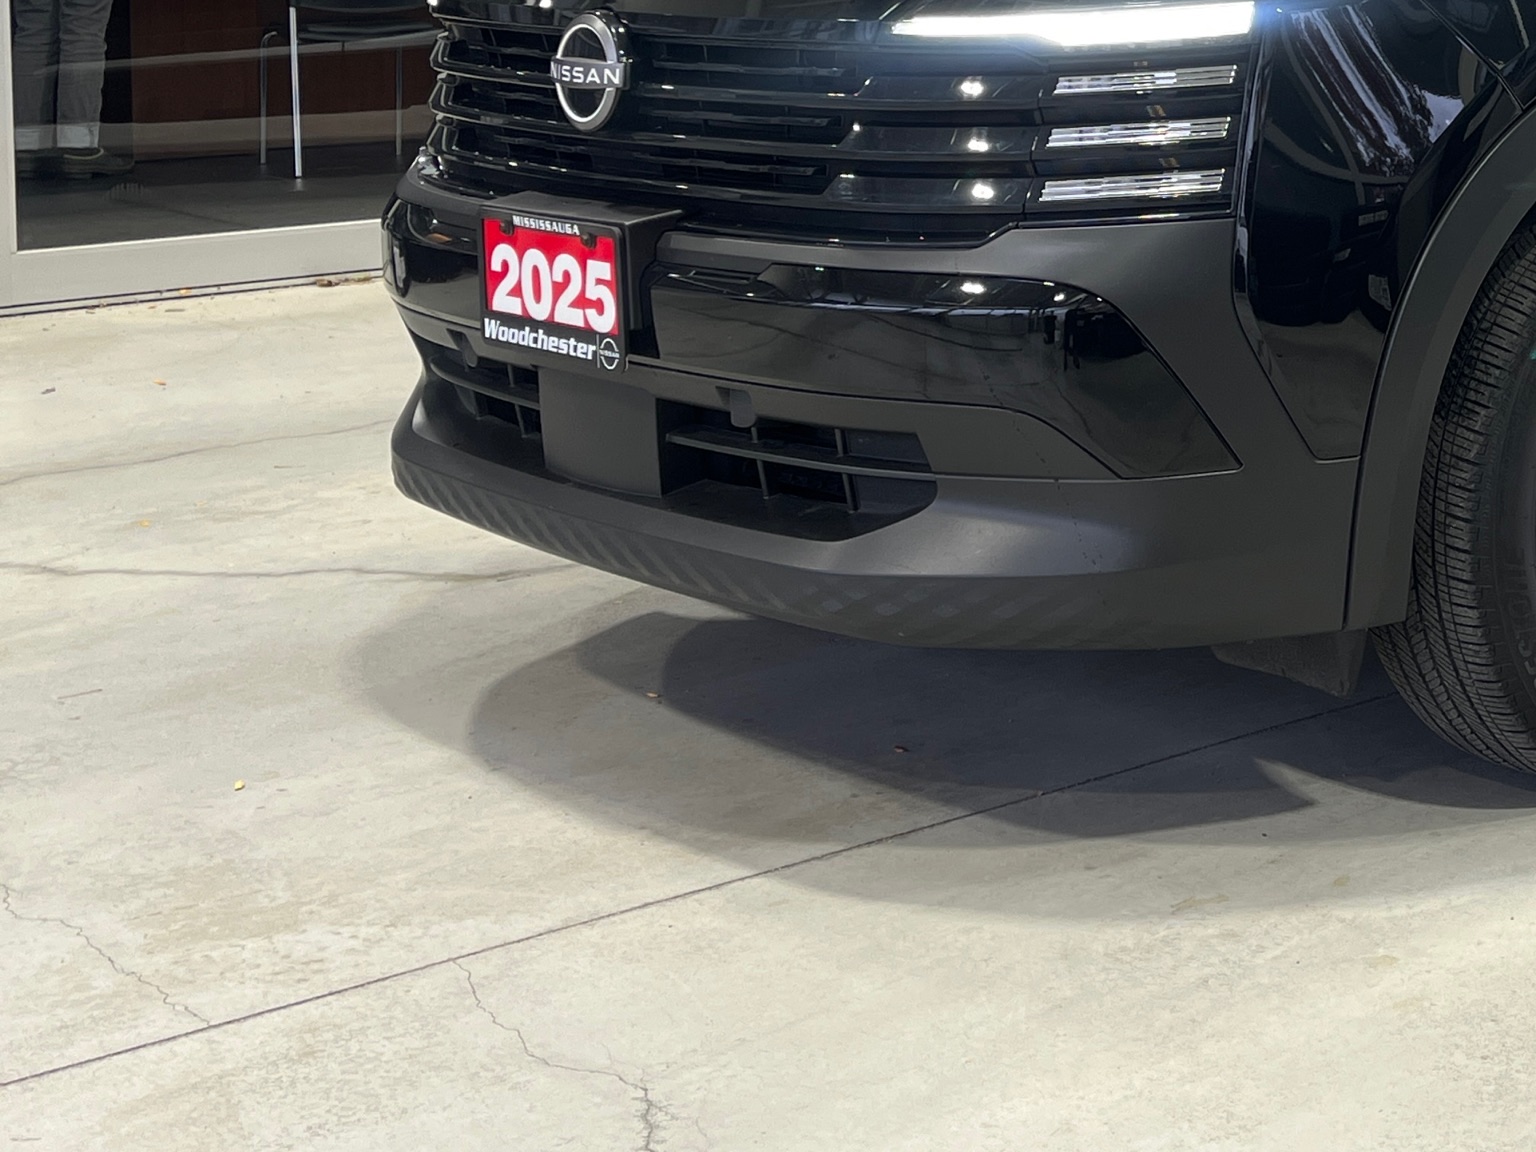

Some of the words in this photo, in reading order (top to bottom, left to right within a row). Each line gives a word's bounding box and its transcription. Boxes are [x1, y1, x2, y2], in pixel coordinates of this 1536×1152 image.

[550, 61, 620, 85] NISSAN
[512, 215, 580, 236] MISSISSAUGA
[490, 243, 616, 334] 2025
[483, 317, 596, 361] Woodchester
